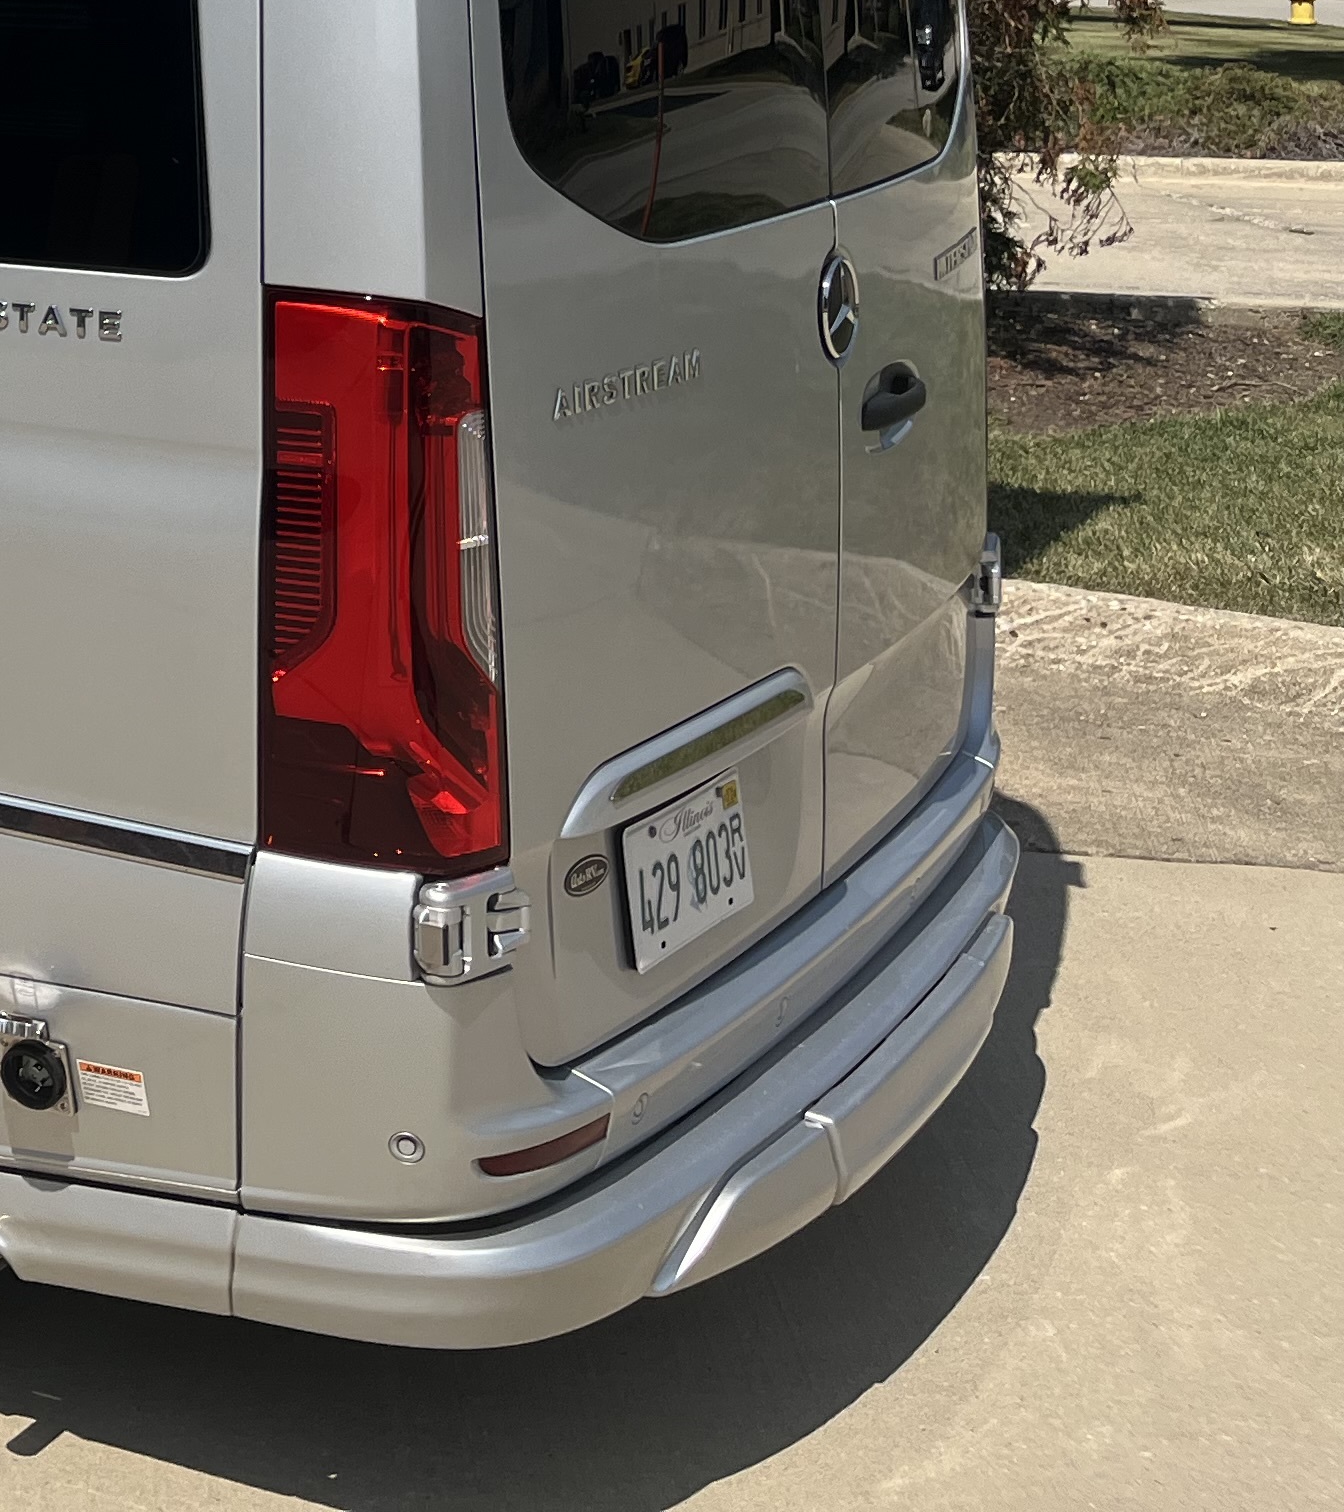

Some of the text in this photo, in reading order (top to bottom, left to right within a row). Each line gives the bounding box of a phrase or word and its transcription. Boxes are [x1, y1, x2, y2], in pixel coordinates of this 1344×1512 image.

[552, 347, 701, 421] AIRSTREAM
[659, 800, 714, 843] Illinois
[639, 853, 681, 935] 429
[692, 823, 734, 905] 803
